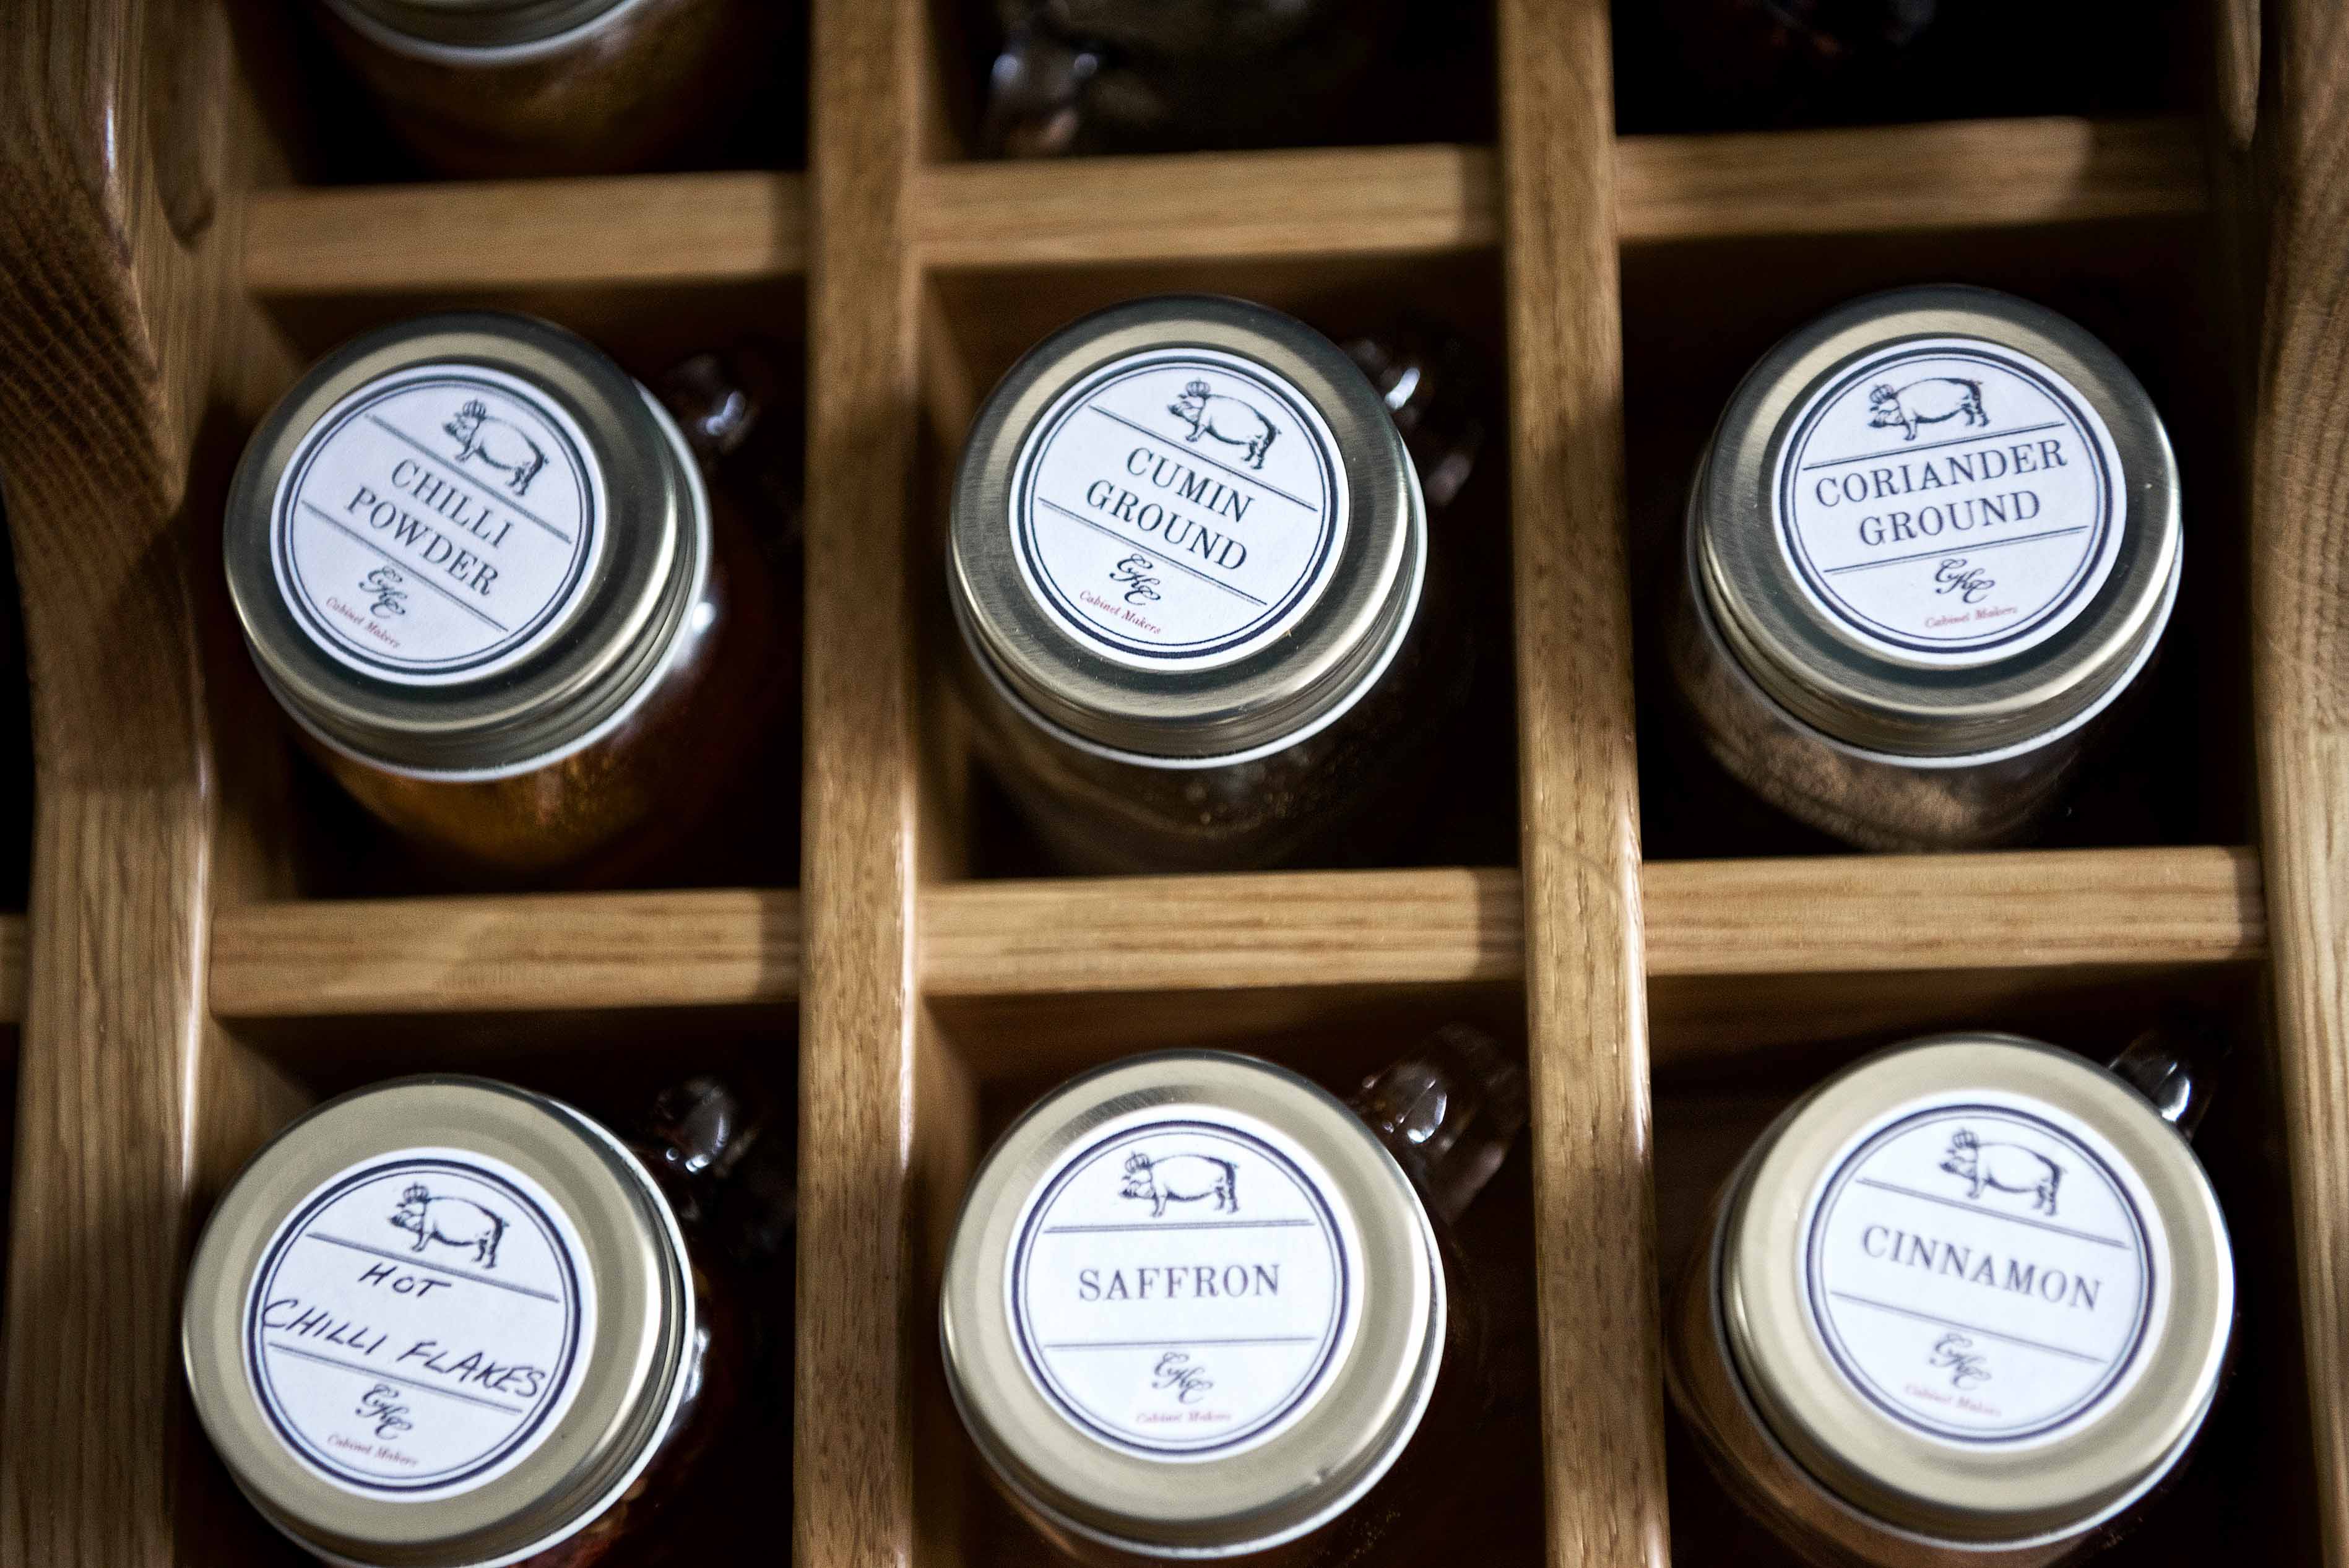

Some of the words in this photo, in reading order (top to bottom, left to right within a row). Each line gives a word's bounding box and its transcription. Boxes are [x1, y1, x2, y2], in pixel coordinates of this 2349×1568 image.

[391, 458, 515, 549] CHILLI
[1127, 447, 1255, 522] CUMIN
[1815, 439, 2067, 507] CORIANDER
[345, 485, 499, 597] POWDER
[1086, 480, 1247, 571] GROUND
[1860, 490, 2040, 546] GROUND
[326, 597, 365, 626] Cabinet
[366, 621, 400, 649] Makers
[1079, 589, 1121, 619] Cabinet
[1122, 610, 1161, 635] Makers
[1924, 612, 1970, 628] Cabinet
[1975, 605, 2017, 621] Makers
[358, 1263, 452, 1297] HOT
[1079, 1264, 1281, 1301] SAFFRON
[1861, 1225, 2103, 1311] CINNAMON
[262, 1299, 387, 1356] CHILLI
[396, 1340, 546, 1398] FLAKES
